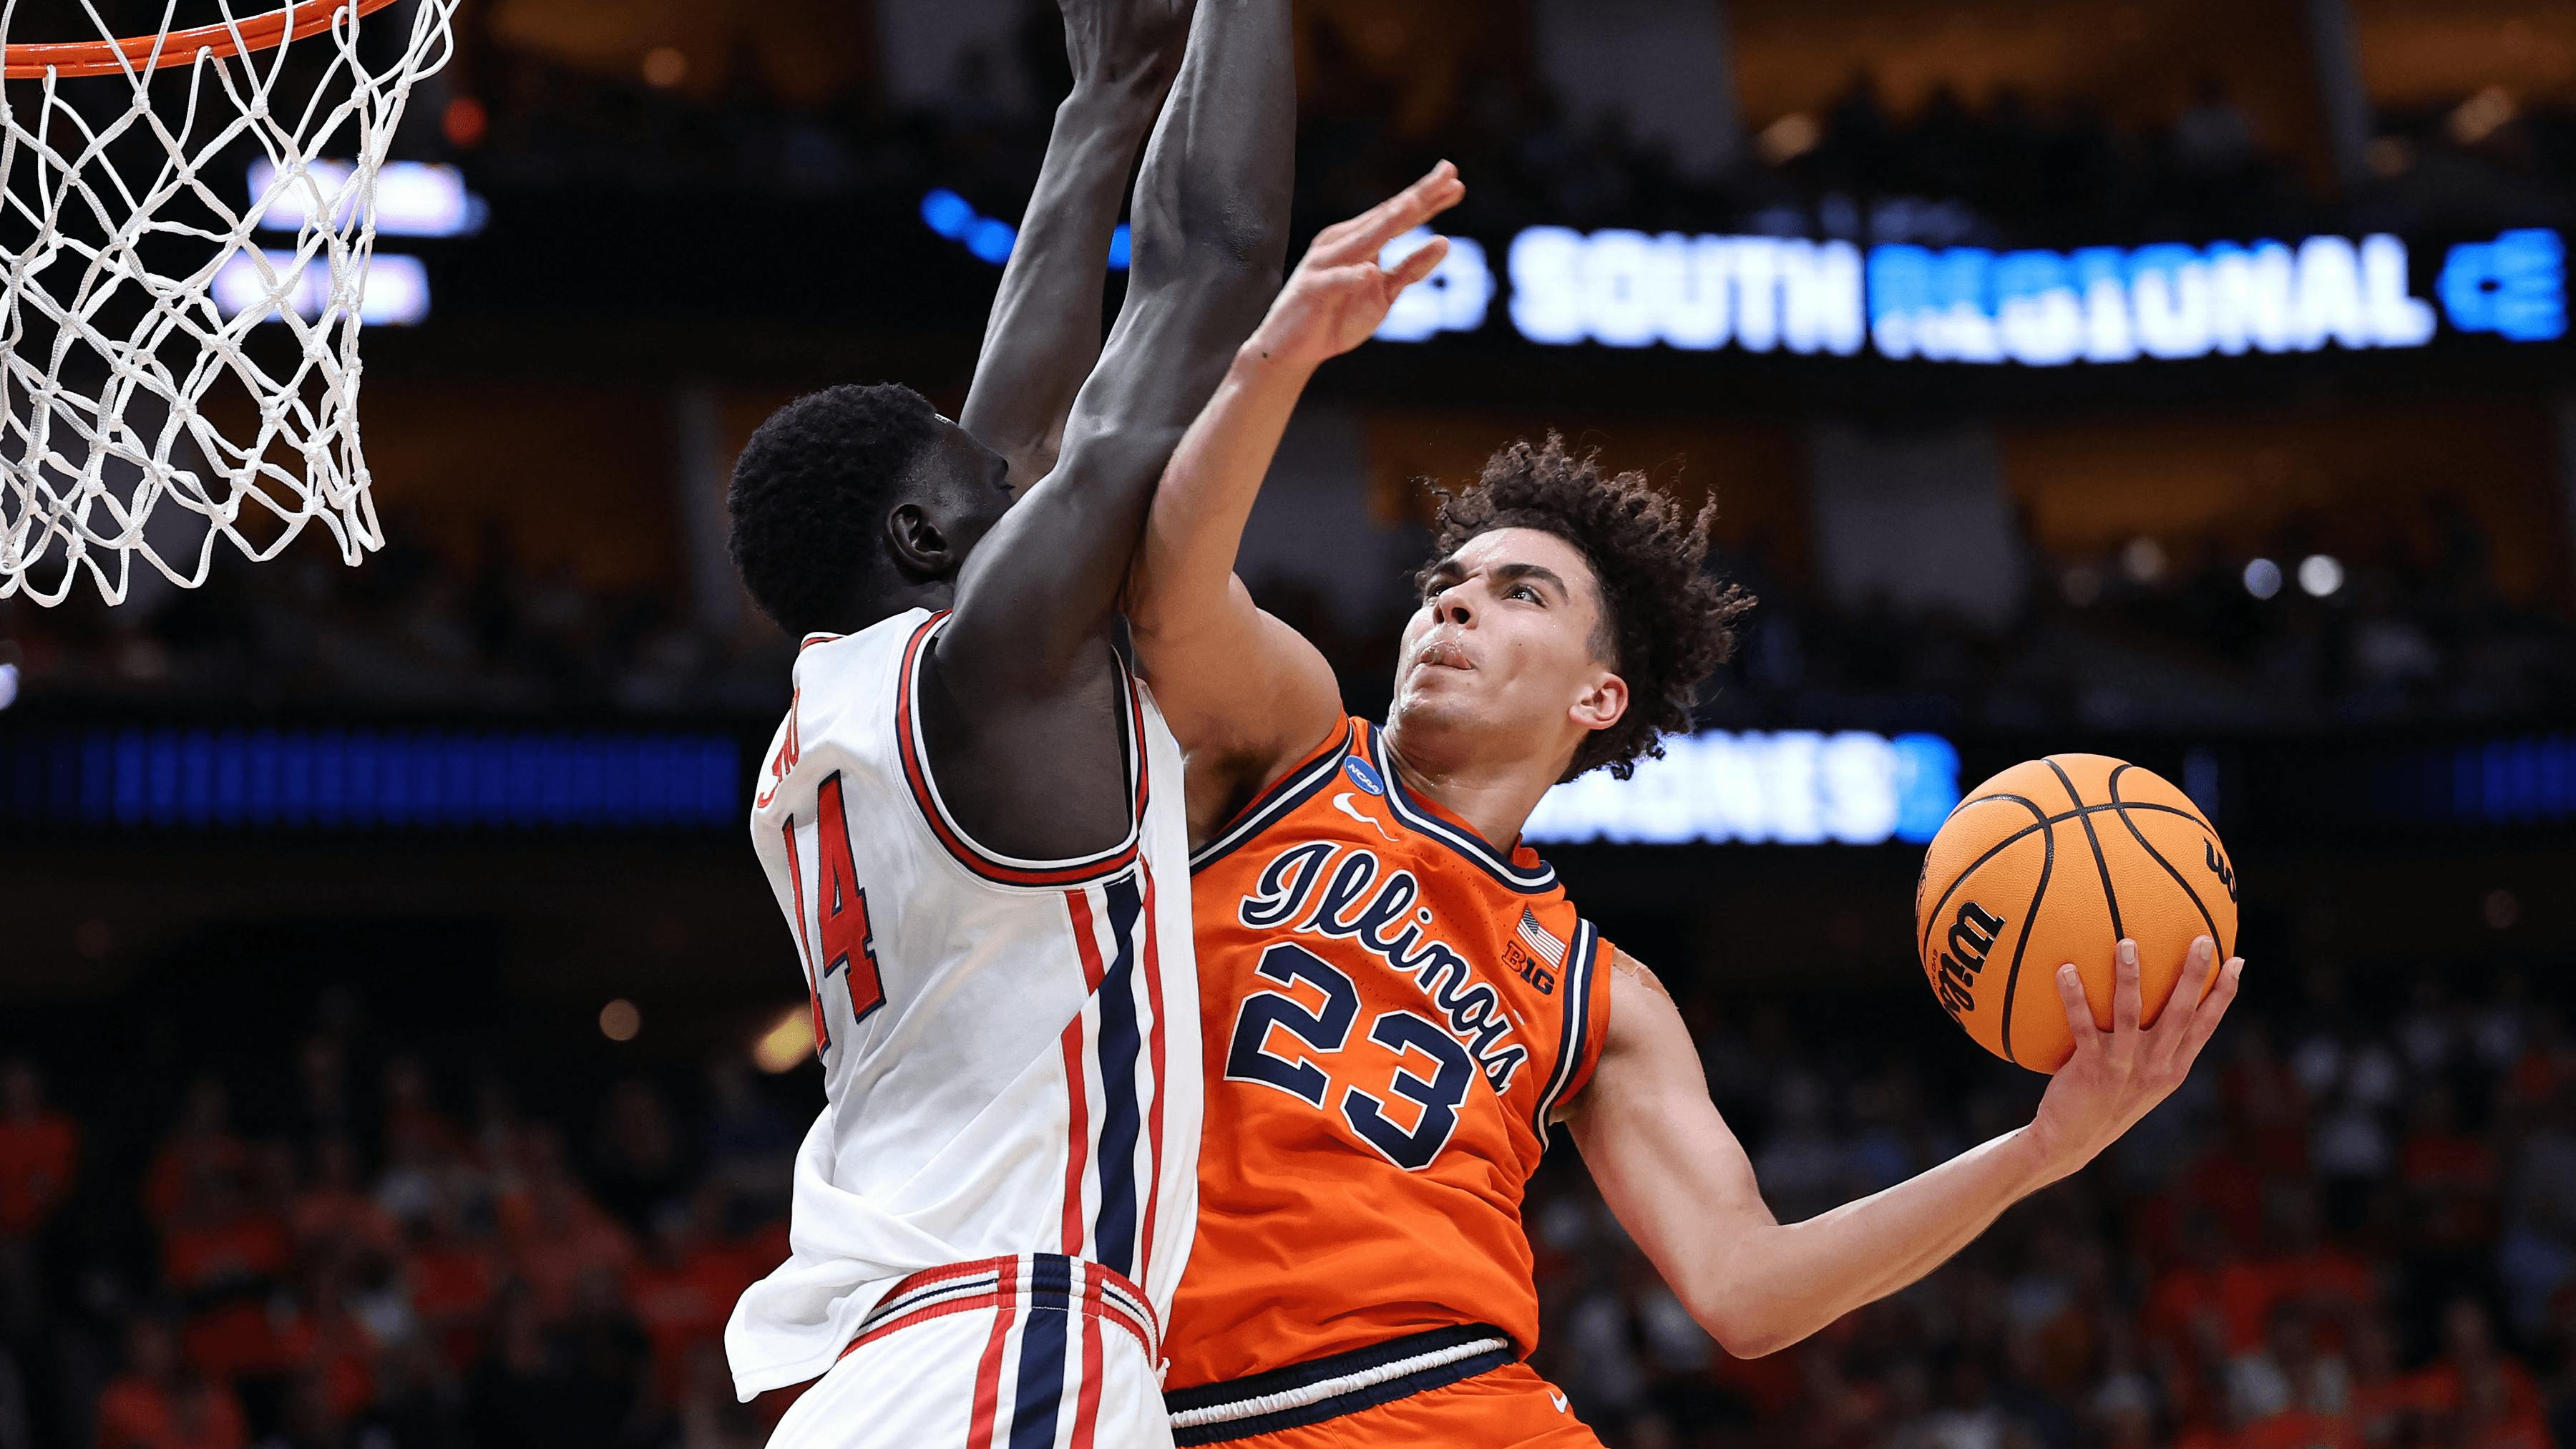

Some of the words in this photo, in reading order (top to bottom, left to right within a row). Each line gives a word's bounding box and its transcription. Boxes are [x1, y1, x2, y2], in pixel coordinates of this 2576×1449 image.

[1507, 225, 1864, 356] SOUTH
[1864, 233, 2436, 366] REGIONAL
[1347, 763, 1380, 794] NCAA
[782, 769, 887, 1064] 14
[1237, 841, 1529, 1096] Illinois
[1223, 941, 1477, 1172] 23
